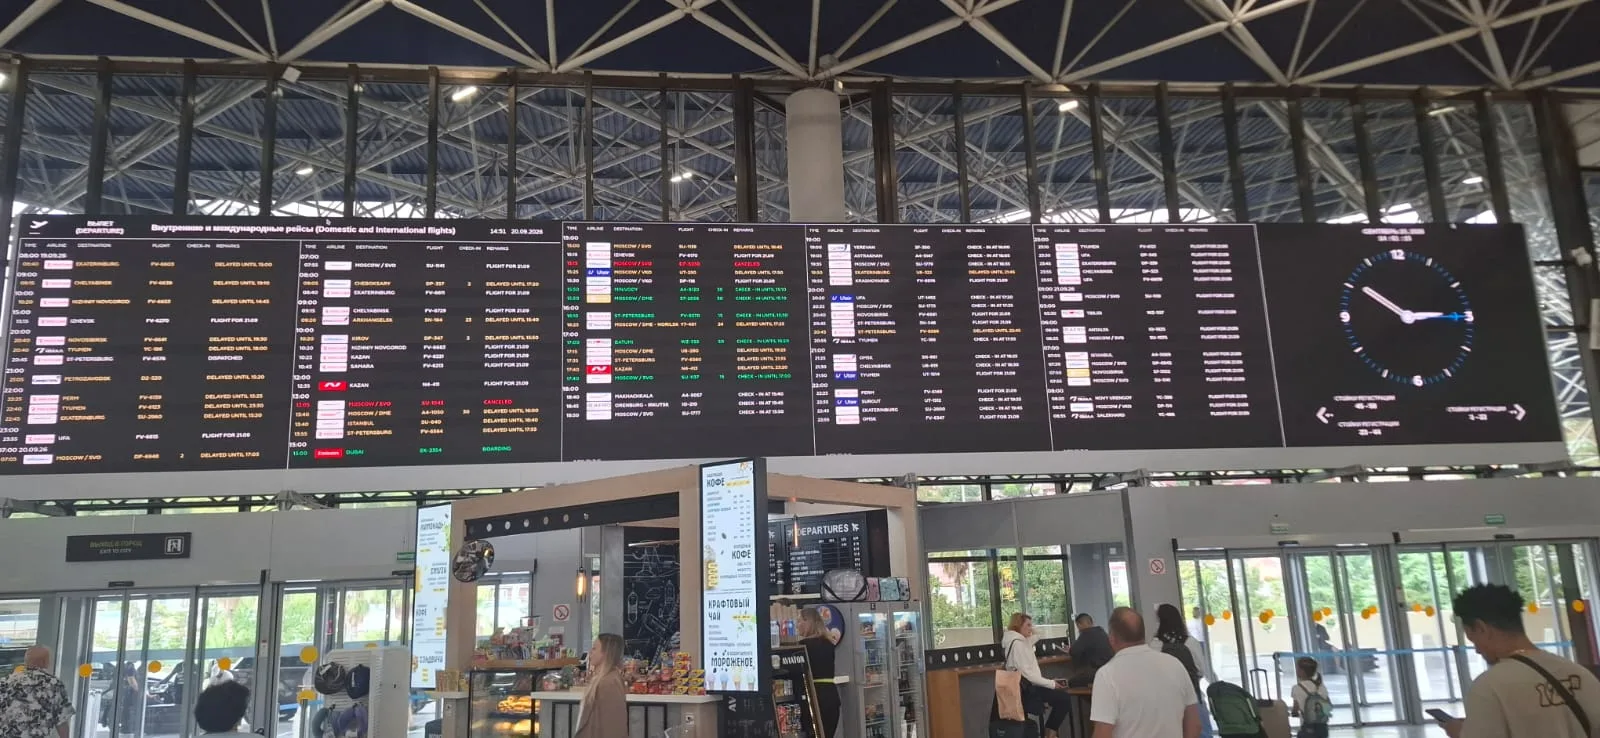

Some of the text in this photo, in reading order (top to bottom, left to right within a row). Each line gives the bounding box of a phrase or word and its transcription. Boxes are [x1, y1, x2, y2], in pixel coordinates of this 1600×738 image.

[75, 226, 124, 236] (DEPARTURE)
[151, 224, 314, 233] Внутренние и международные рейсы
[315, 225, 456, 236] (Domestic and International flights)
[1391, 249, 1405, 259] 12
[1340, 312, 1349, 322] 9
[1413, 376, 1422, 386] 6
[706, 477, 725, 487] КОФЕ
[797, 524, 849, 537] DEPARTURES
[731, 550, 752, 560] КОФЕ
[708, 597, 750, 609] КРАФТОВЫЙ
[708, 611, 721, 620] ЧАЙ
[711, 657, 753, 667] МОРОЖЕНОЕ
